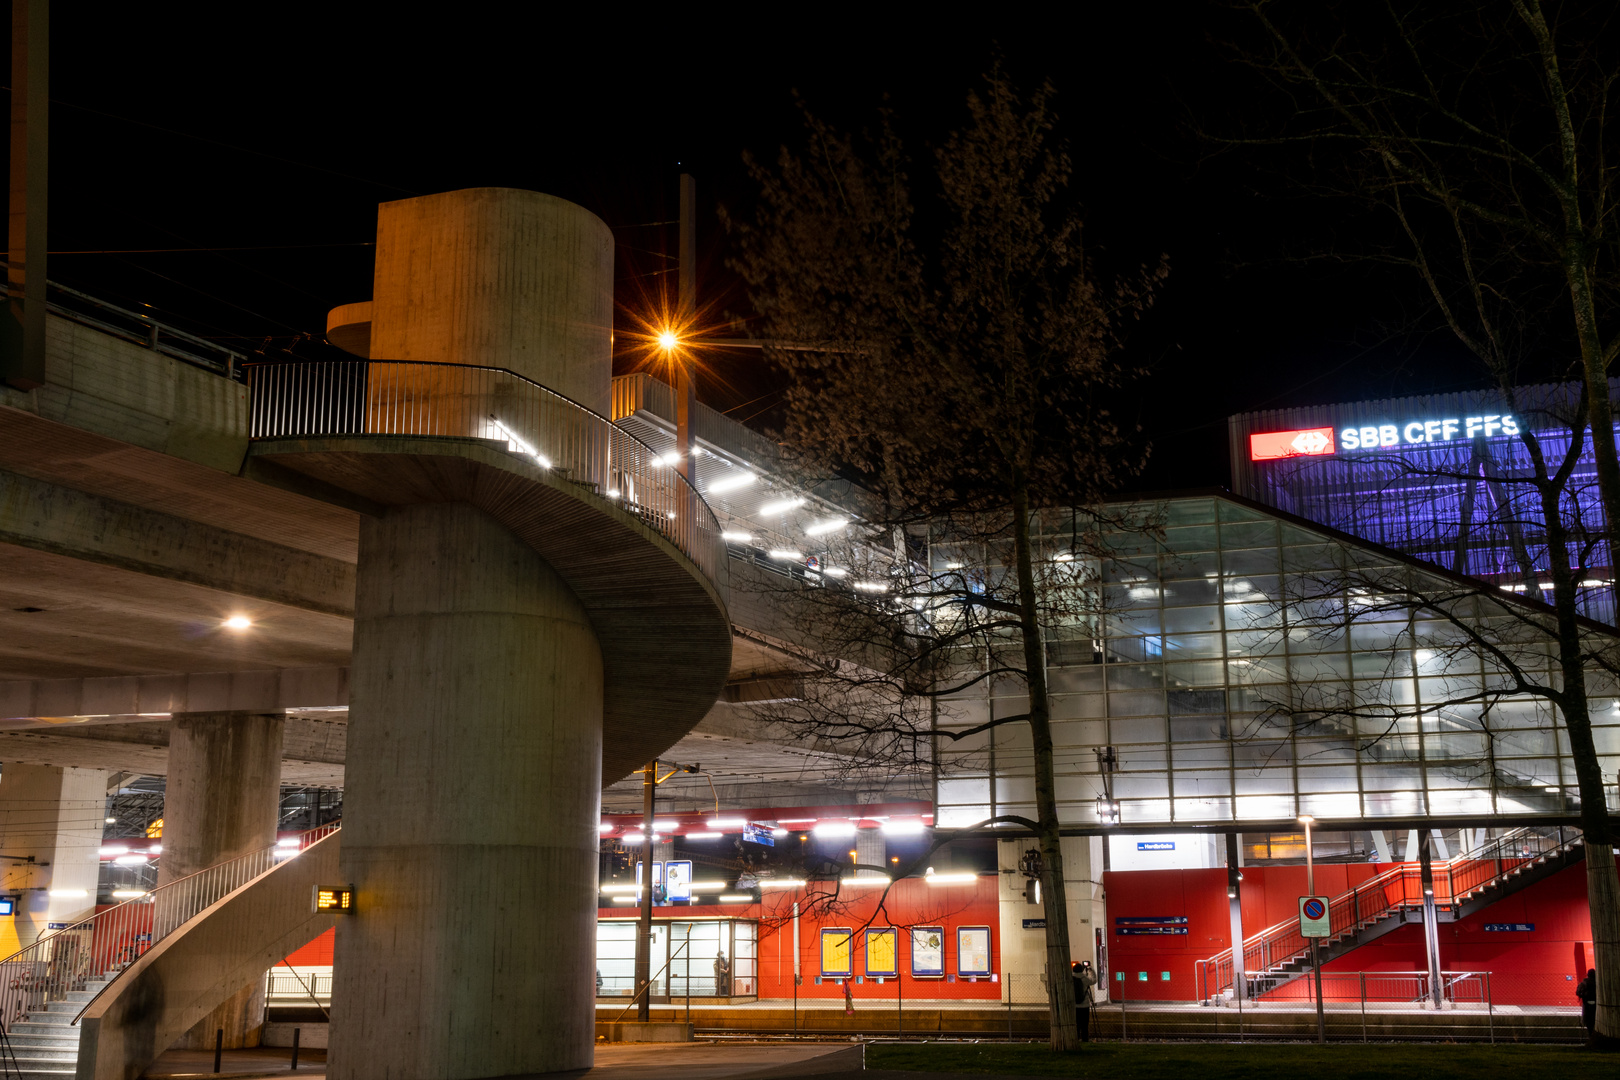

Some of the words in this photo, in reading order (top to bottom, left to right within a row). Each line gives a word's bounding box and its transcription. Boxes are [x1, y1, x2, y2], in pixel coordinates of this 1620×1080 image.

[1340, 424, 1399, 450] SBB
[1404, 419, 1459, 444] CFF
[1465, 414, 1519, 439] FFS
